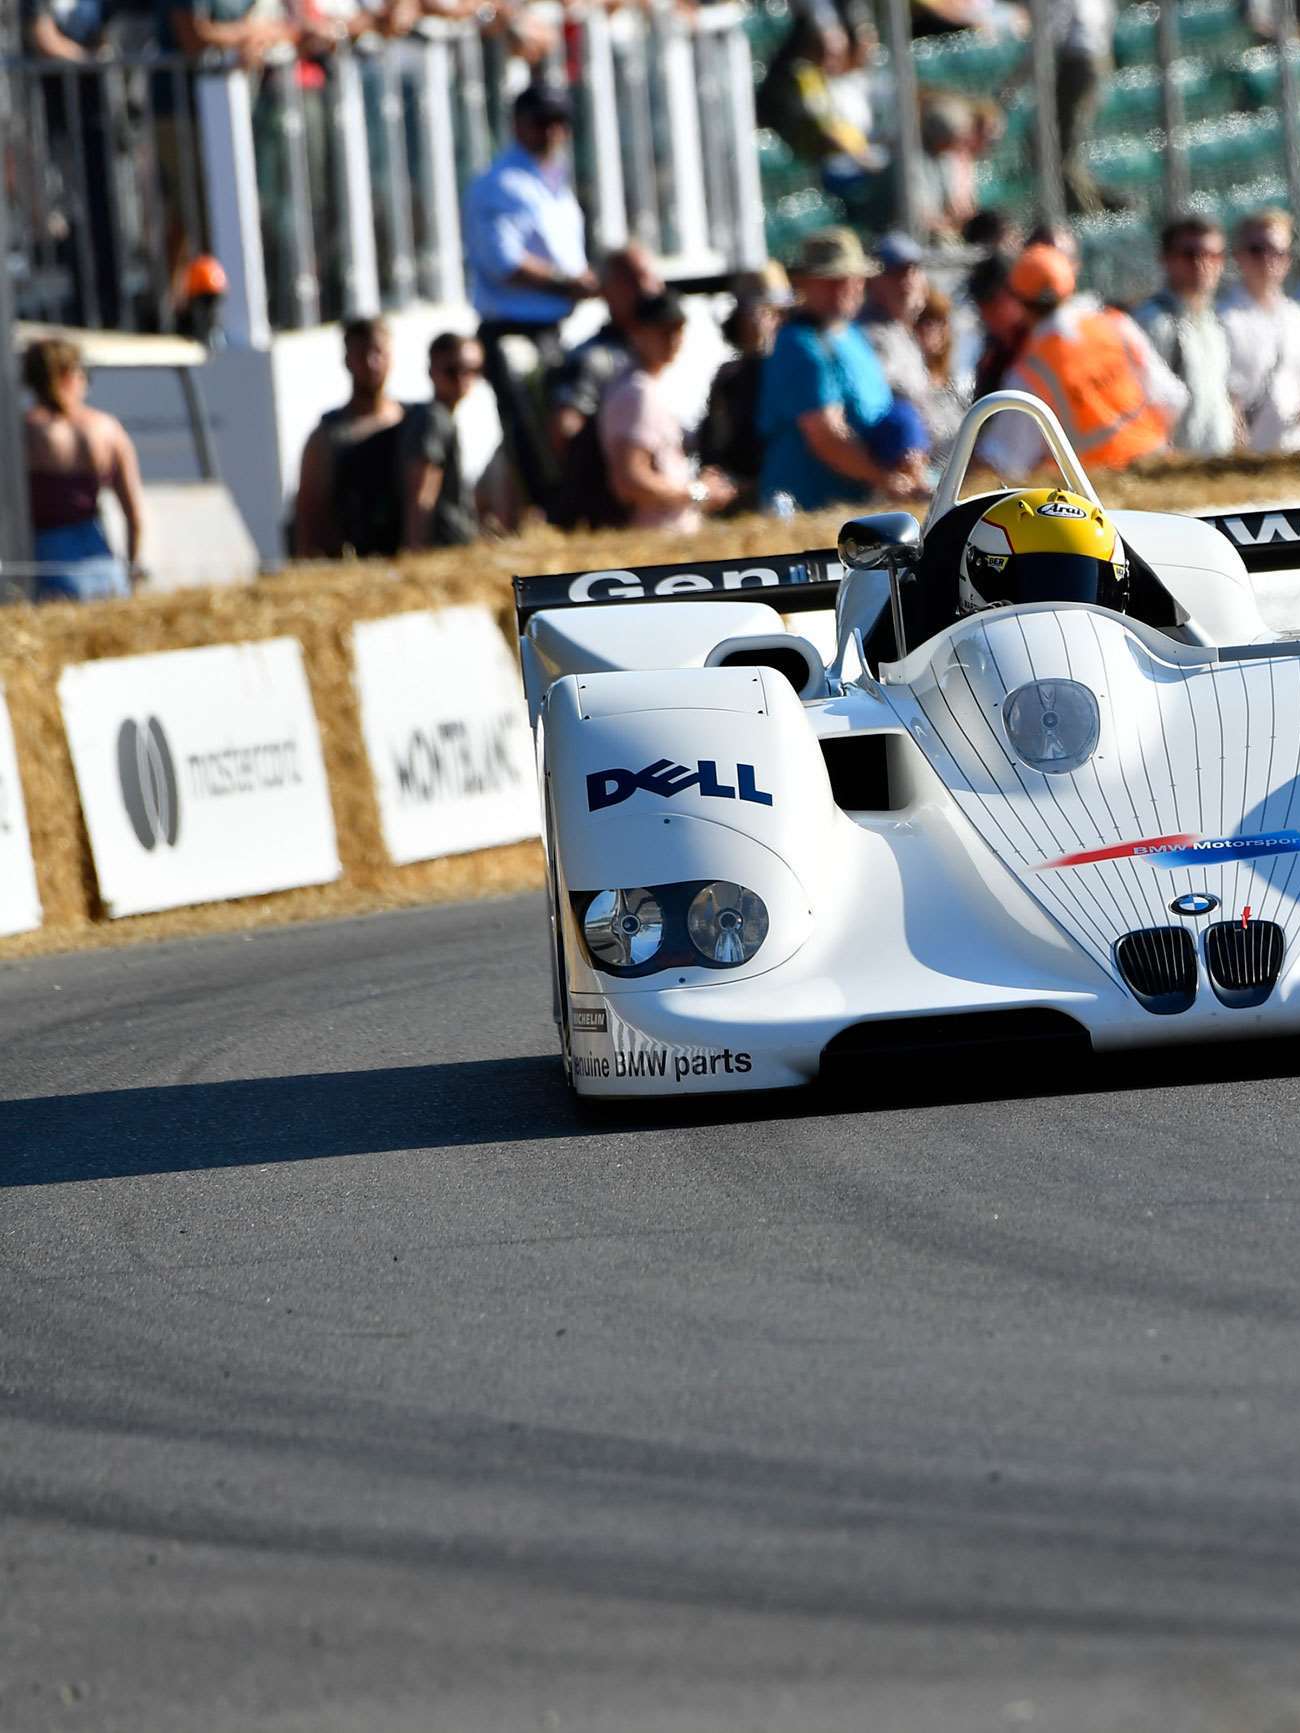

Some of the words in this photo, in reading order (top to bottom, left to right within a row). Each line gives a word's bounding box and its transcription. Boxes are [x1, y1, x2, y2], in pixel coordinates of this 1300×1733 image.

[1043, 503, 1081, 515] Arai
[585, 758, 774, 813] DELL
[1133, 843, 1188, 855] BMW
[614, 1049, 667, 1078] BMW
[674, 1047, 753, 1082] parts
